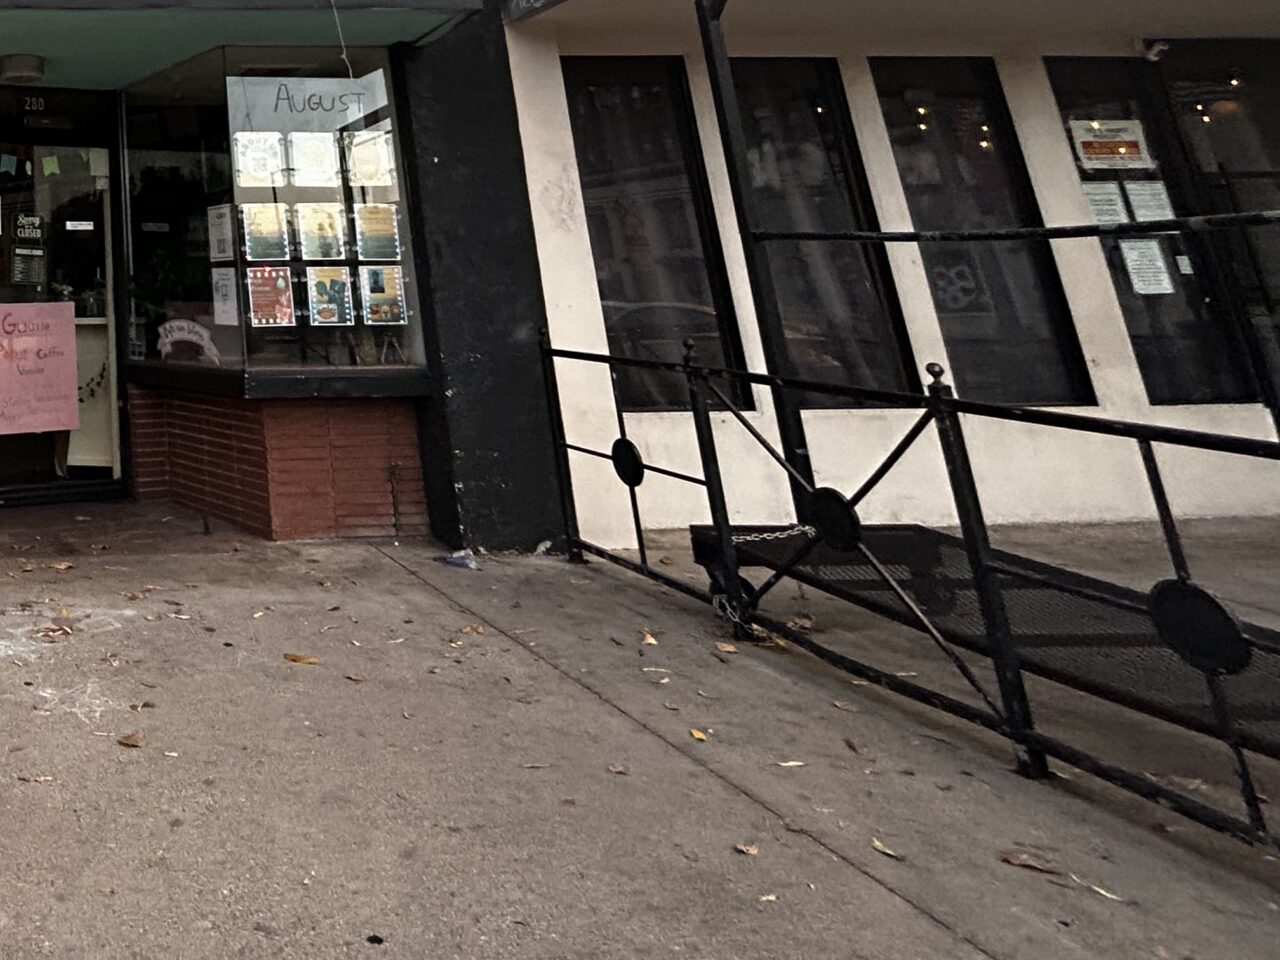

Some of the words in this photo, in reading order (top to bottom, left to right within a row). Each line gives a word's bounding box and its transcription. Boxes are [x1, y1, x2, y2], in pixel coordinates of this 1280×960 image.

[24, 96, 45, 111] 280
[274, 83, 366, 113] AUGUST
[17, 228, 42, 238] CLOSED
